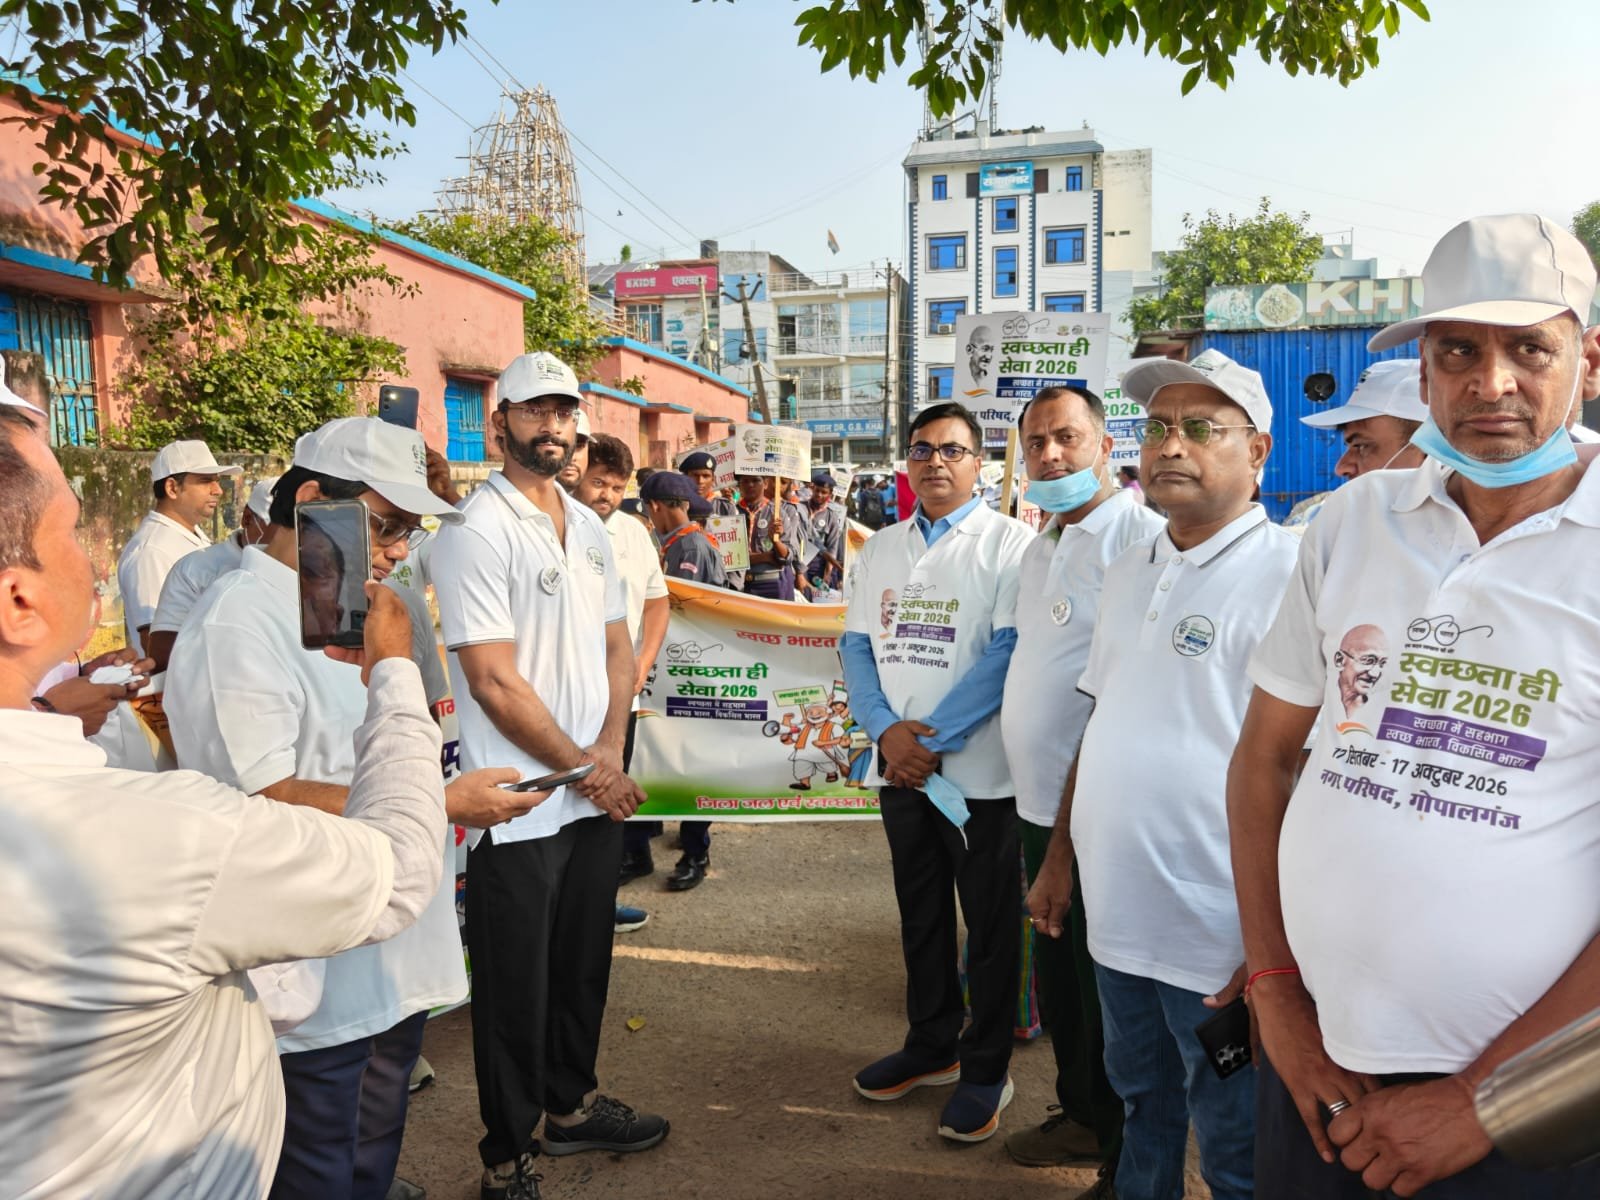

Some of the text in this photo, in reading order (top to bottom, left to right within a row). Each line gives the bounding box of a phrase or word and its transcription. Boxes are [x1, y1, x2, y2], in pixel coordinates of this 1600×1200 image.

[1001, 337, 1090, 356] स्वच्छता ही
[998, 357, 1077, 375] सेवा 2026
[945, 598, 959, 612] ही
[898, 610, 951, 624] सेवा 2026
[734, 630, 837, 648] स्वच्छ भारत
[666, 662, 769, 680] स्वच्छता ही
[1399, 652, 1562, 703] स्वच्छता ही
[676, 680, 717, 697] सेवा
[721, 684, 758, 698] 2026
[1391, 675, 1532, 728] सेवा 2026
[1450, 720, 1465, 735] में
[1465, 726, 1510, 746] सहभाग
[1385, 728, 1413, 743] स्वच्छ
[1447, 737, 1496, 761] विकसित
[1497, 752, 1530, 768] भारत
[1392, 758, 1410, 776] 17
[1465, 774, 1508, 796] 2026
[697, 795, 738, 810] जिला
[741, 797, 775, 810] जल
[777, 795, 802, 810] एवं
[805, 797, 868, 810] स्वच्छता
[1409, 789, 1522, 830] गोपालगंज
